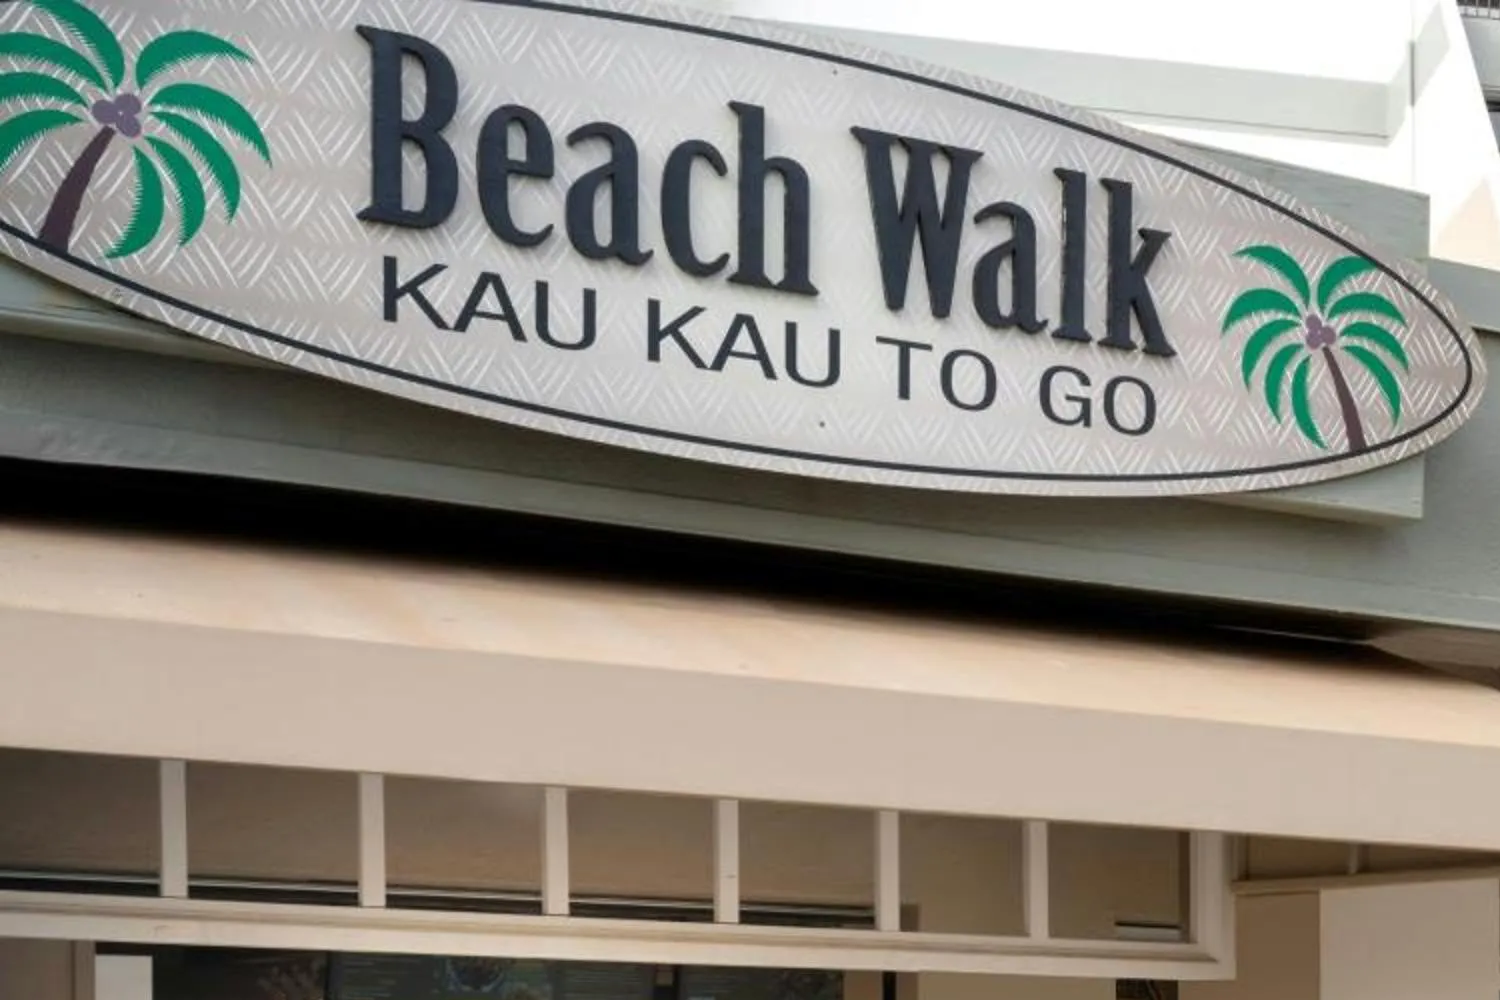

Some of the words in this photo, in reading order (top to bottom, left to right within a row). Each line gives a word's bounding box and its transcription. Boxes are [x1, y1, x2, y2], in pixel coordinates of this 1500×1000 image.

[355, 24, 819, 297] Beach
[850, 125, 1177, 358] Walk
[382, 255, 597, 351] KAU
[646, 298, 841, 388] KAU
[876, 335, 998, 412] TO
[1039, 365, 1157, 436] GO
